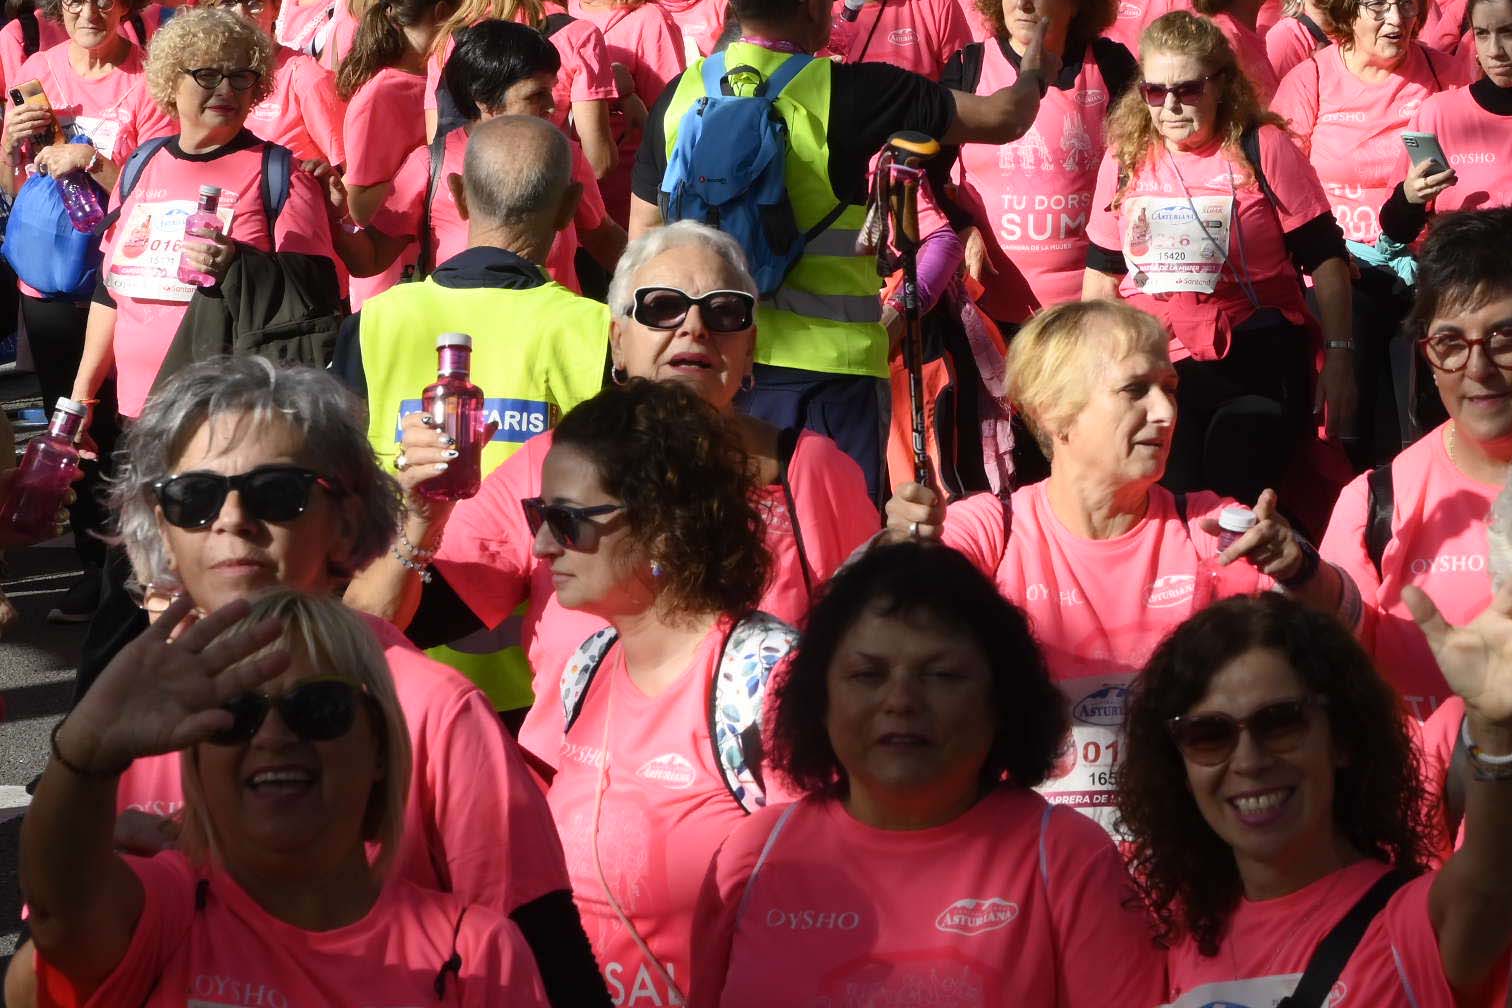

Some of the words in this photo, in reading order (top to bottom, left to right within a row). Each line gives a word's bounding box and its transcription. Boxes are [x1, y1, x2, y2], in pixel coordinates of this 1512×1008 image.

[1451, 153, 1495, 165] OYSHO
[1001, 194, 1030, 211] TU
[1000, 212, 1091, 241] SUM
[1159, 252, 1186, 261] 15420
[1411, 555, 1484, 575] OYSHO
[1082, 741, 1119, 763] 01
[1092, 794, 1108, 803] DE
[767, 908, 860, 931] OYSHO
